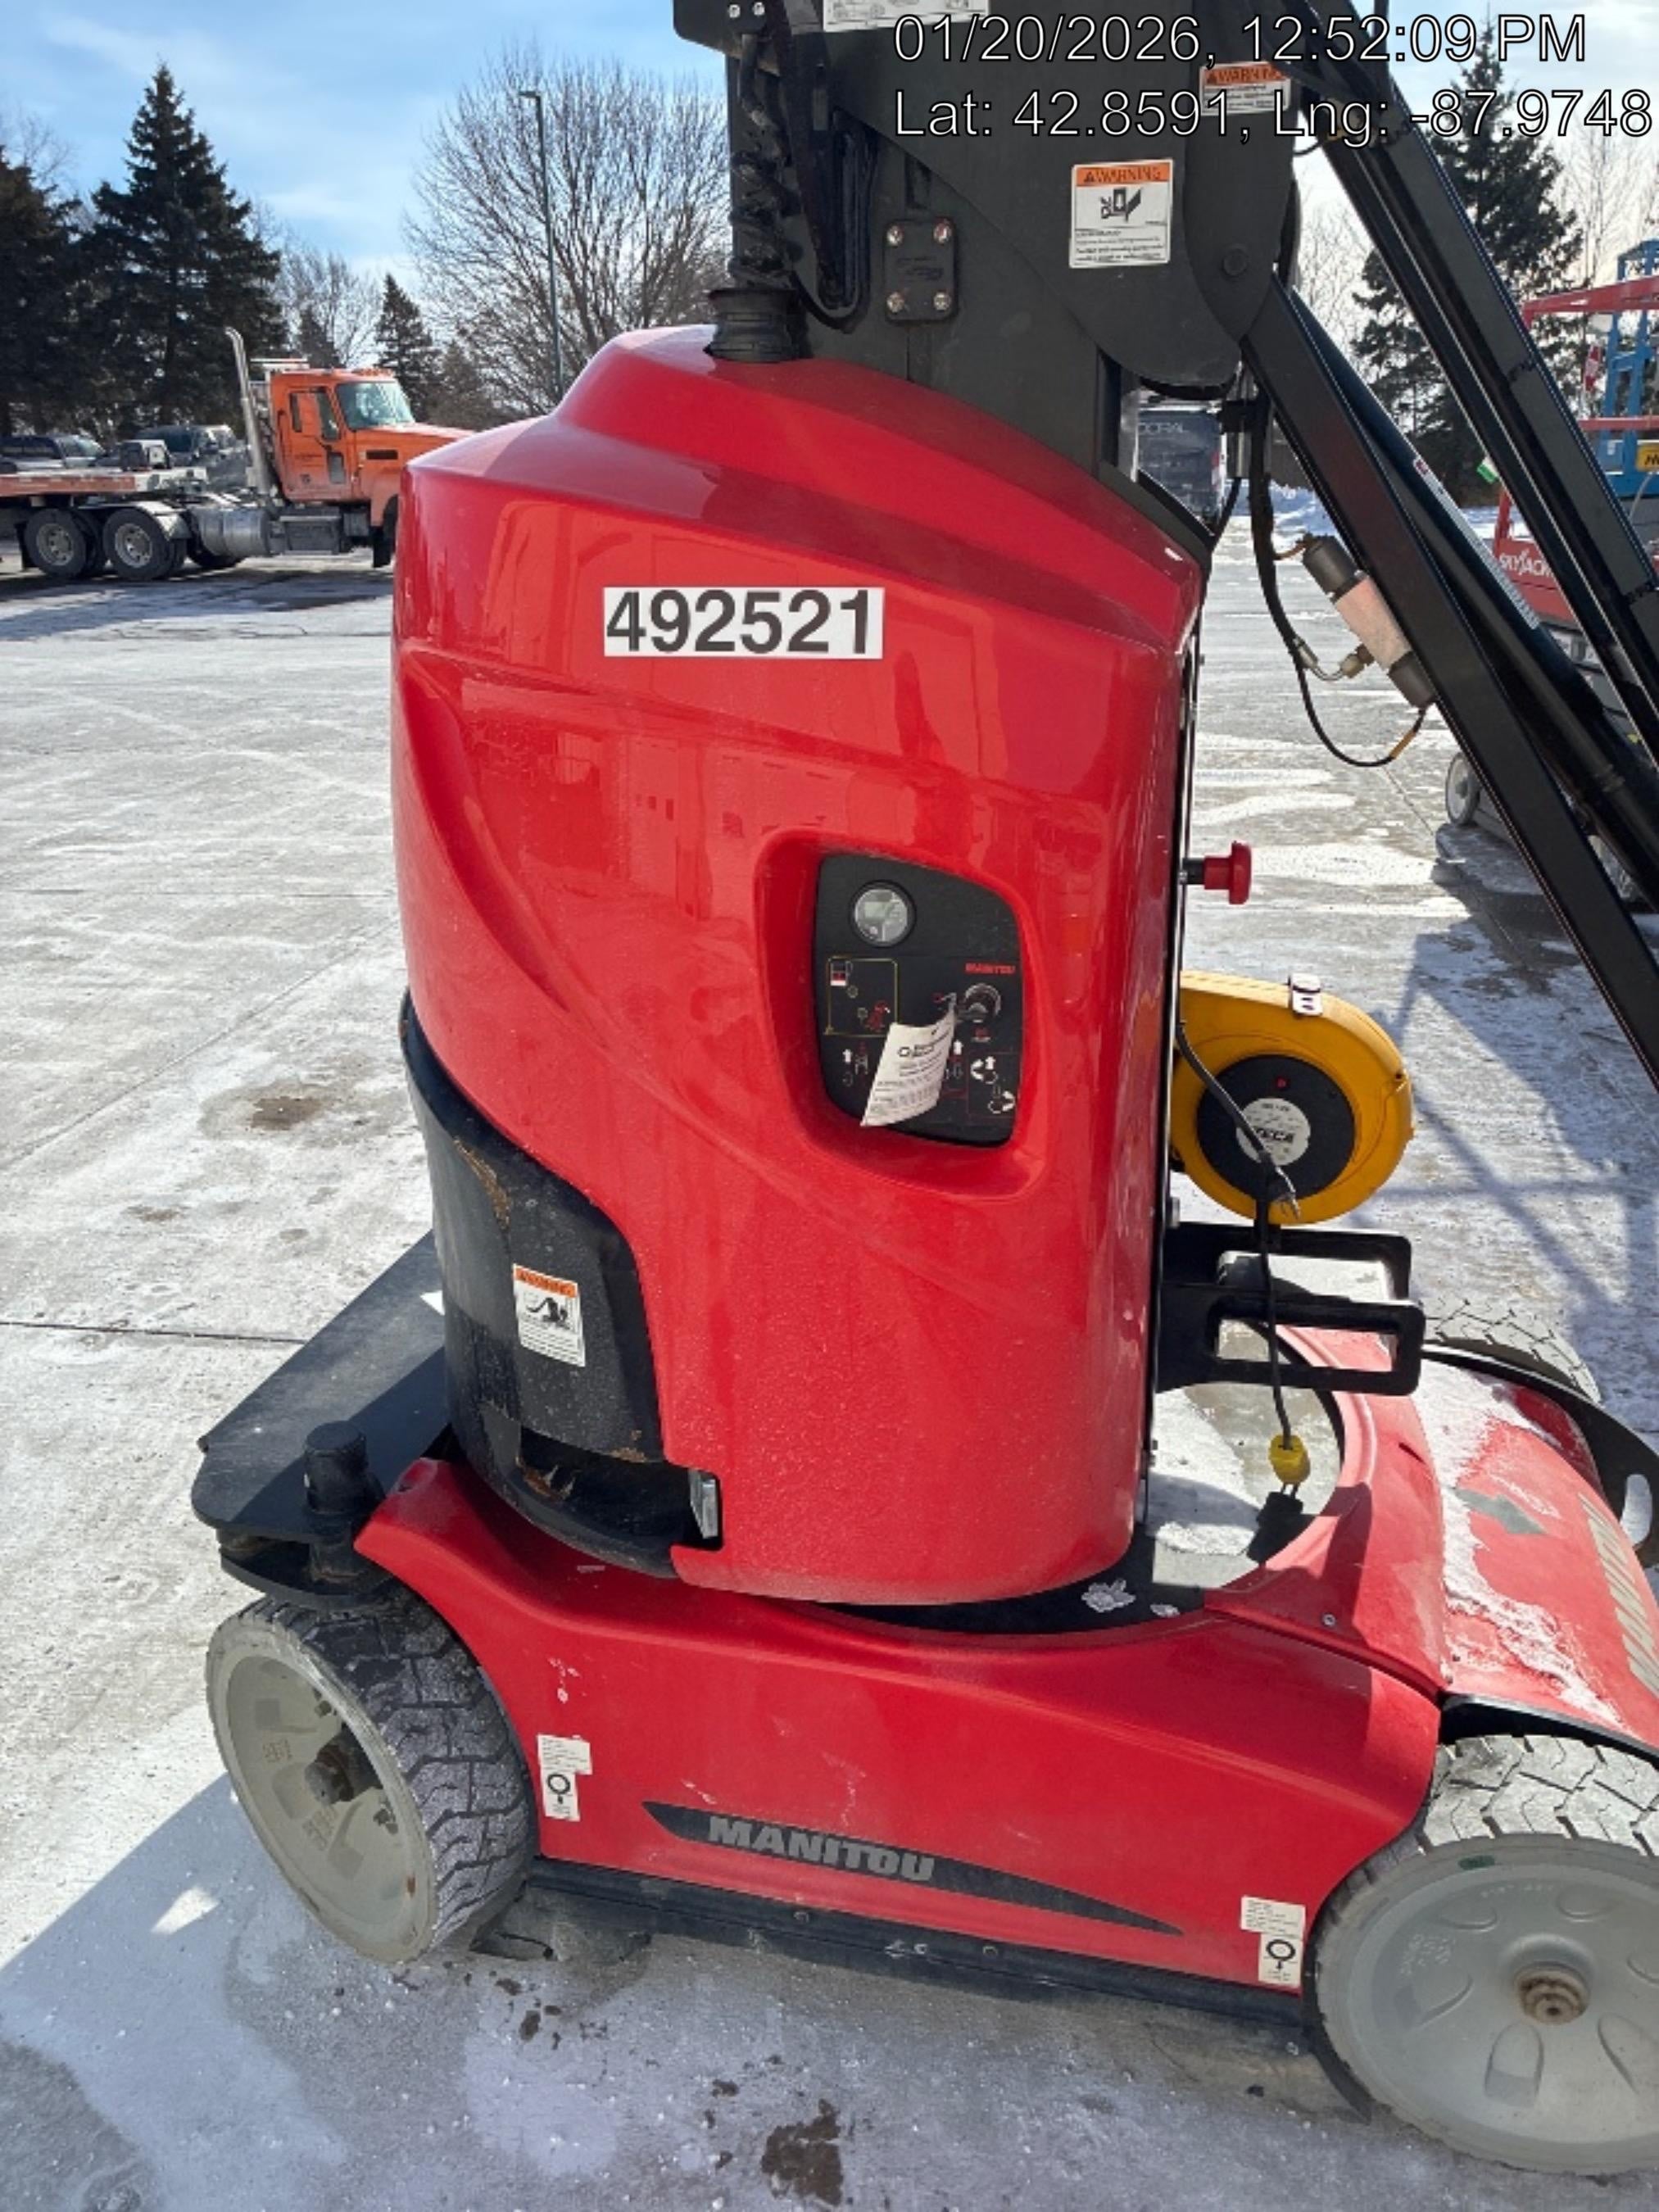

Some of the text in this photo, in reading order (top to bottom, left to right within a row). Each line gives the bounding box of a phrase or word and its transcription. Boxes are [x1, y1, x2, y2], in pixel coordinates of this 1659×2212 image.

[1095, 165, 1161, 182] WARNING
[606, 588, 868, 655] 492521
[708, 1811, 935, 1882] MANITOU
